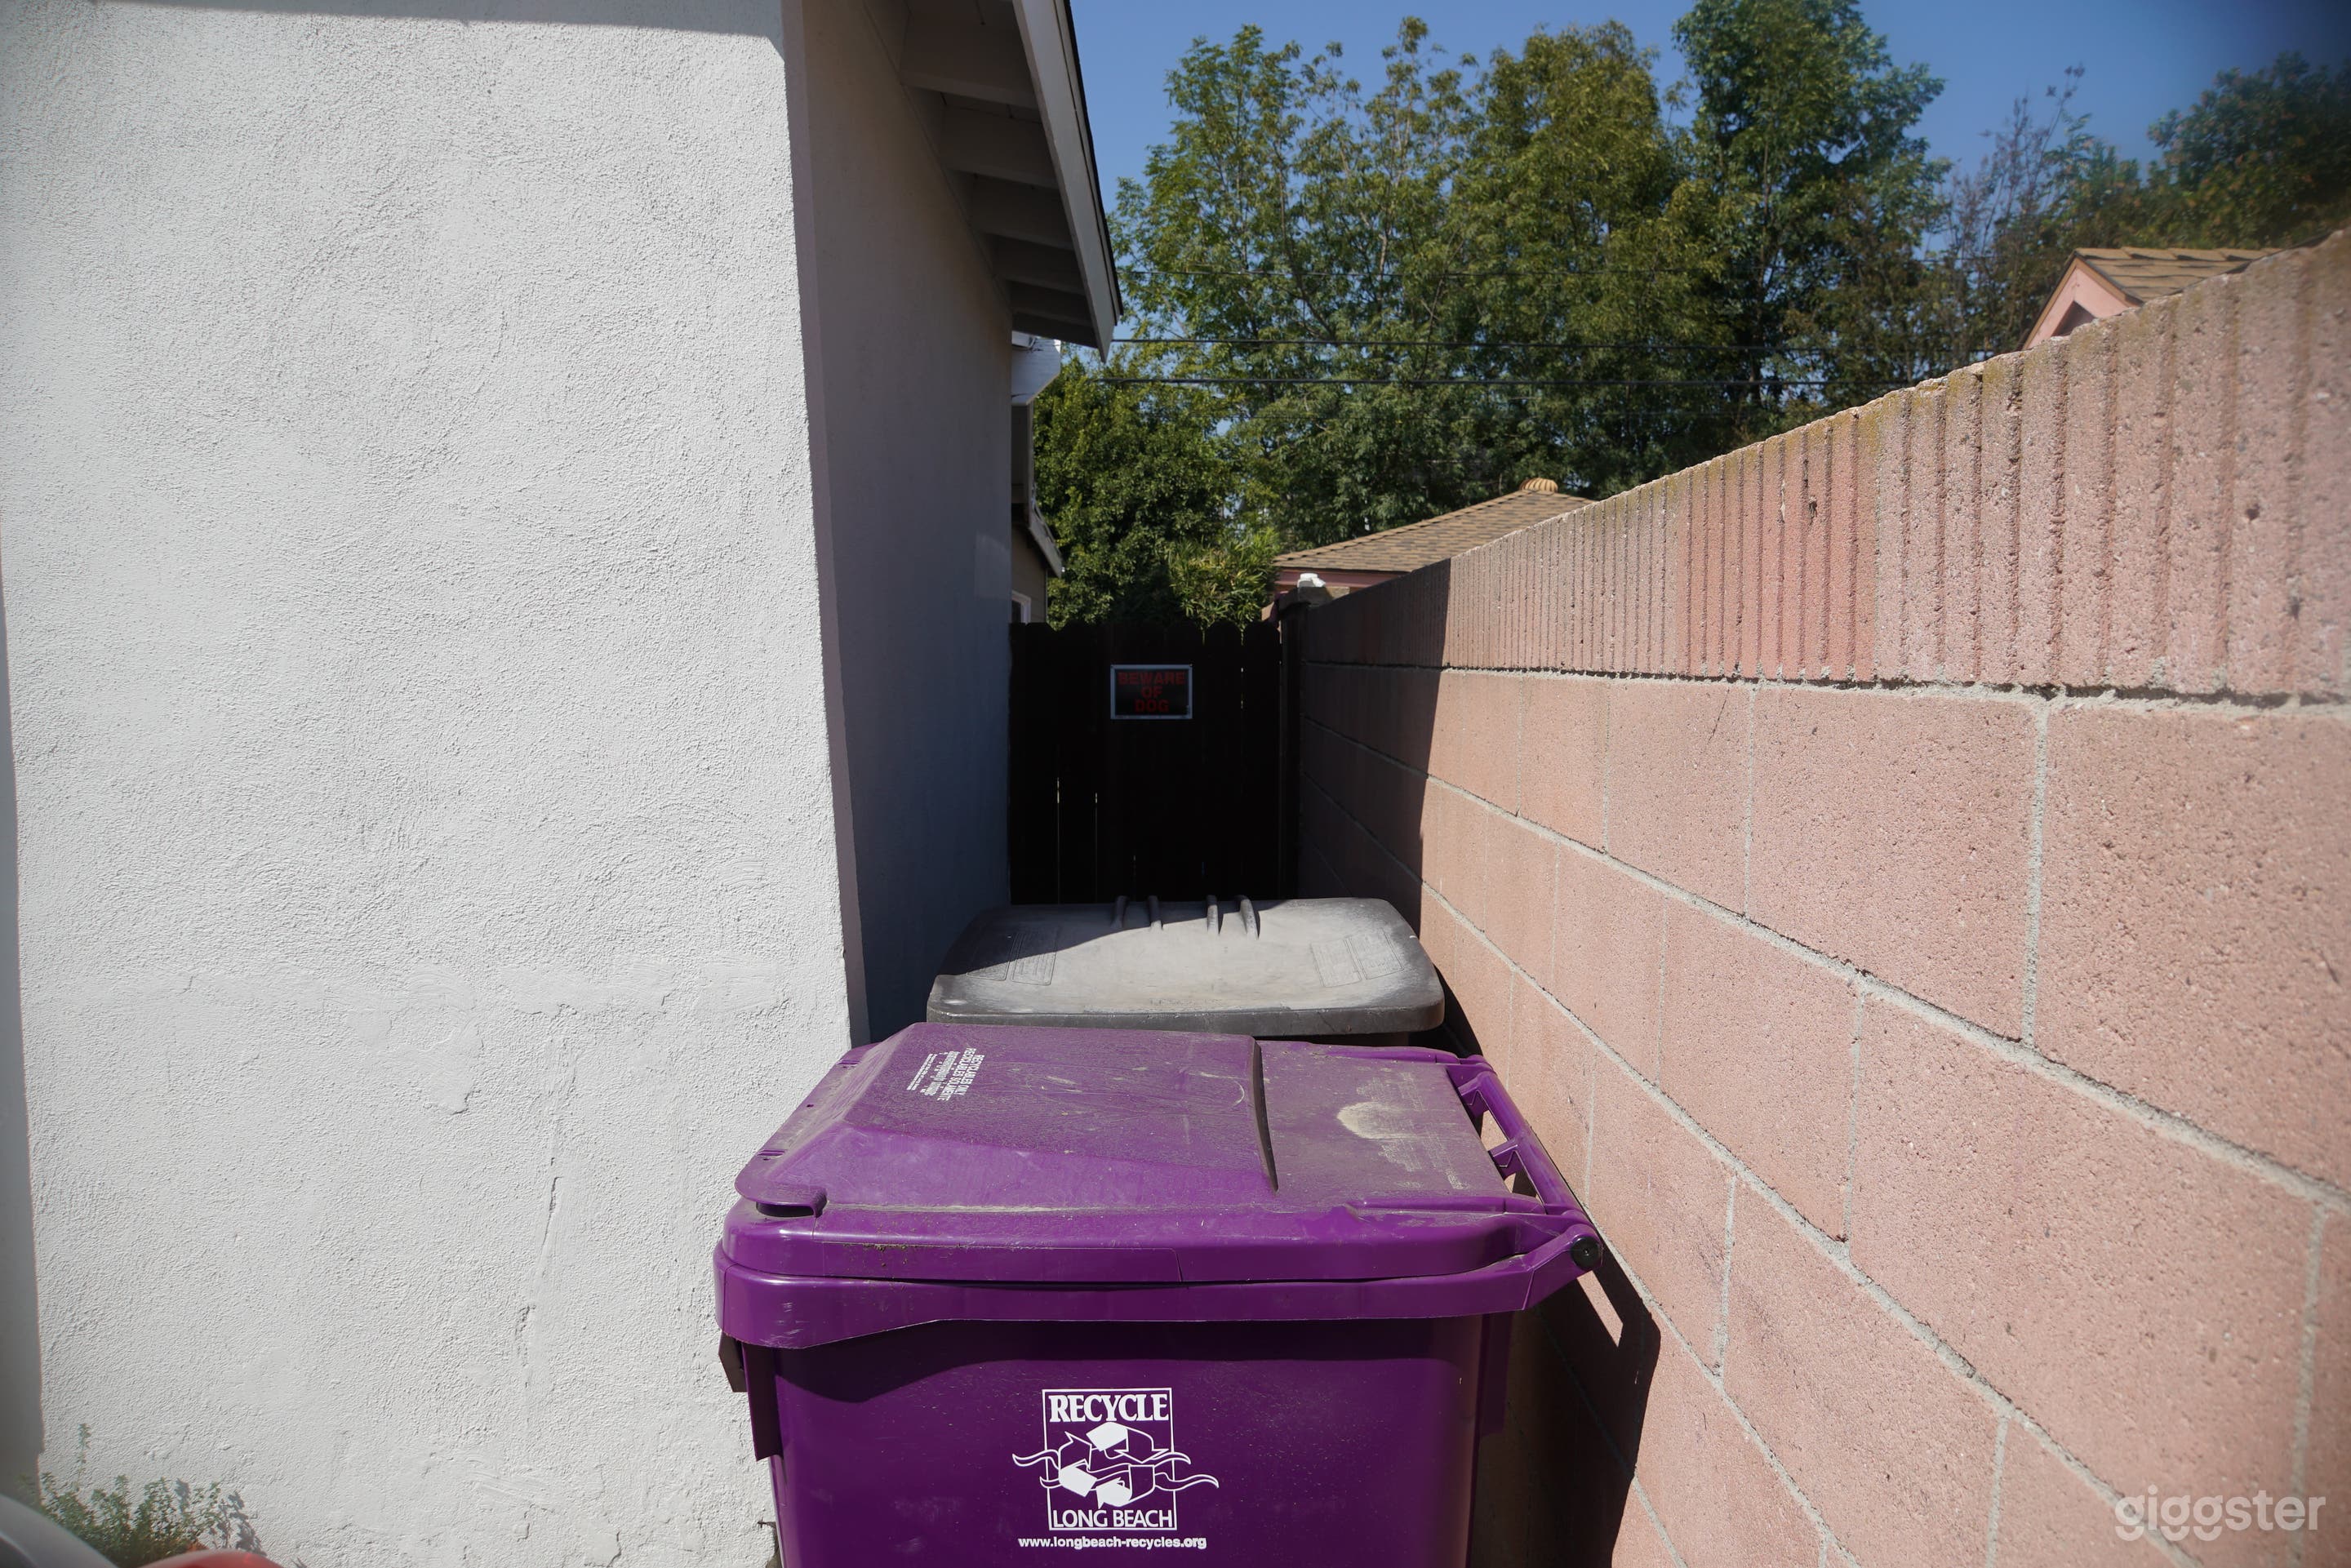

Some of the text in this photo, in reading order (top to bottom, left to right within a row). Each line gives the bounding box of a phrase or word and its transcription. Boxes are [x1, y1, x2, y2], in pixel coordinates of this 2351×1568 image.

[1118, 671, 1185, 685] BEWARE
[1140, 686, 1163, 699] OF
[1135, 700, 1170, 713] DOG
[1048, 1393, 1169, 1423] RECYCLE
[1052, 1509, 1172, 1528] LONG BEACH
[1018, 1536, 1207, 1550] www.longbeach-recycles.org
